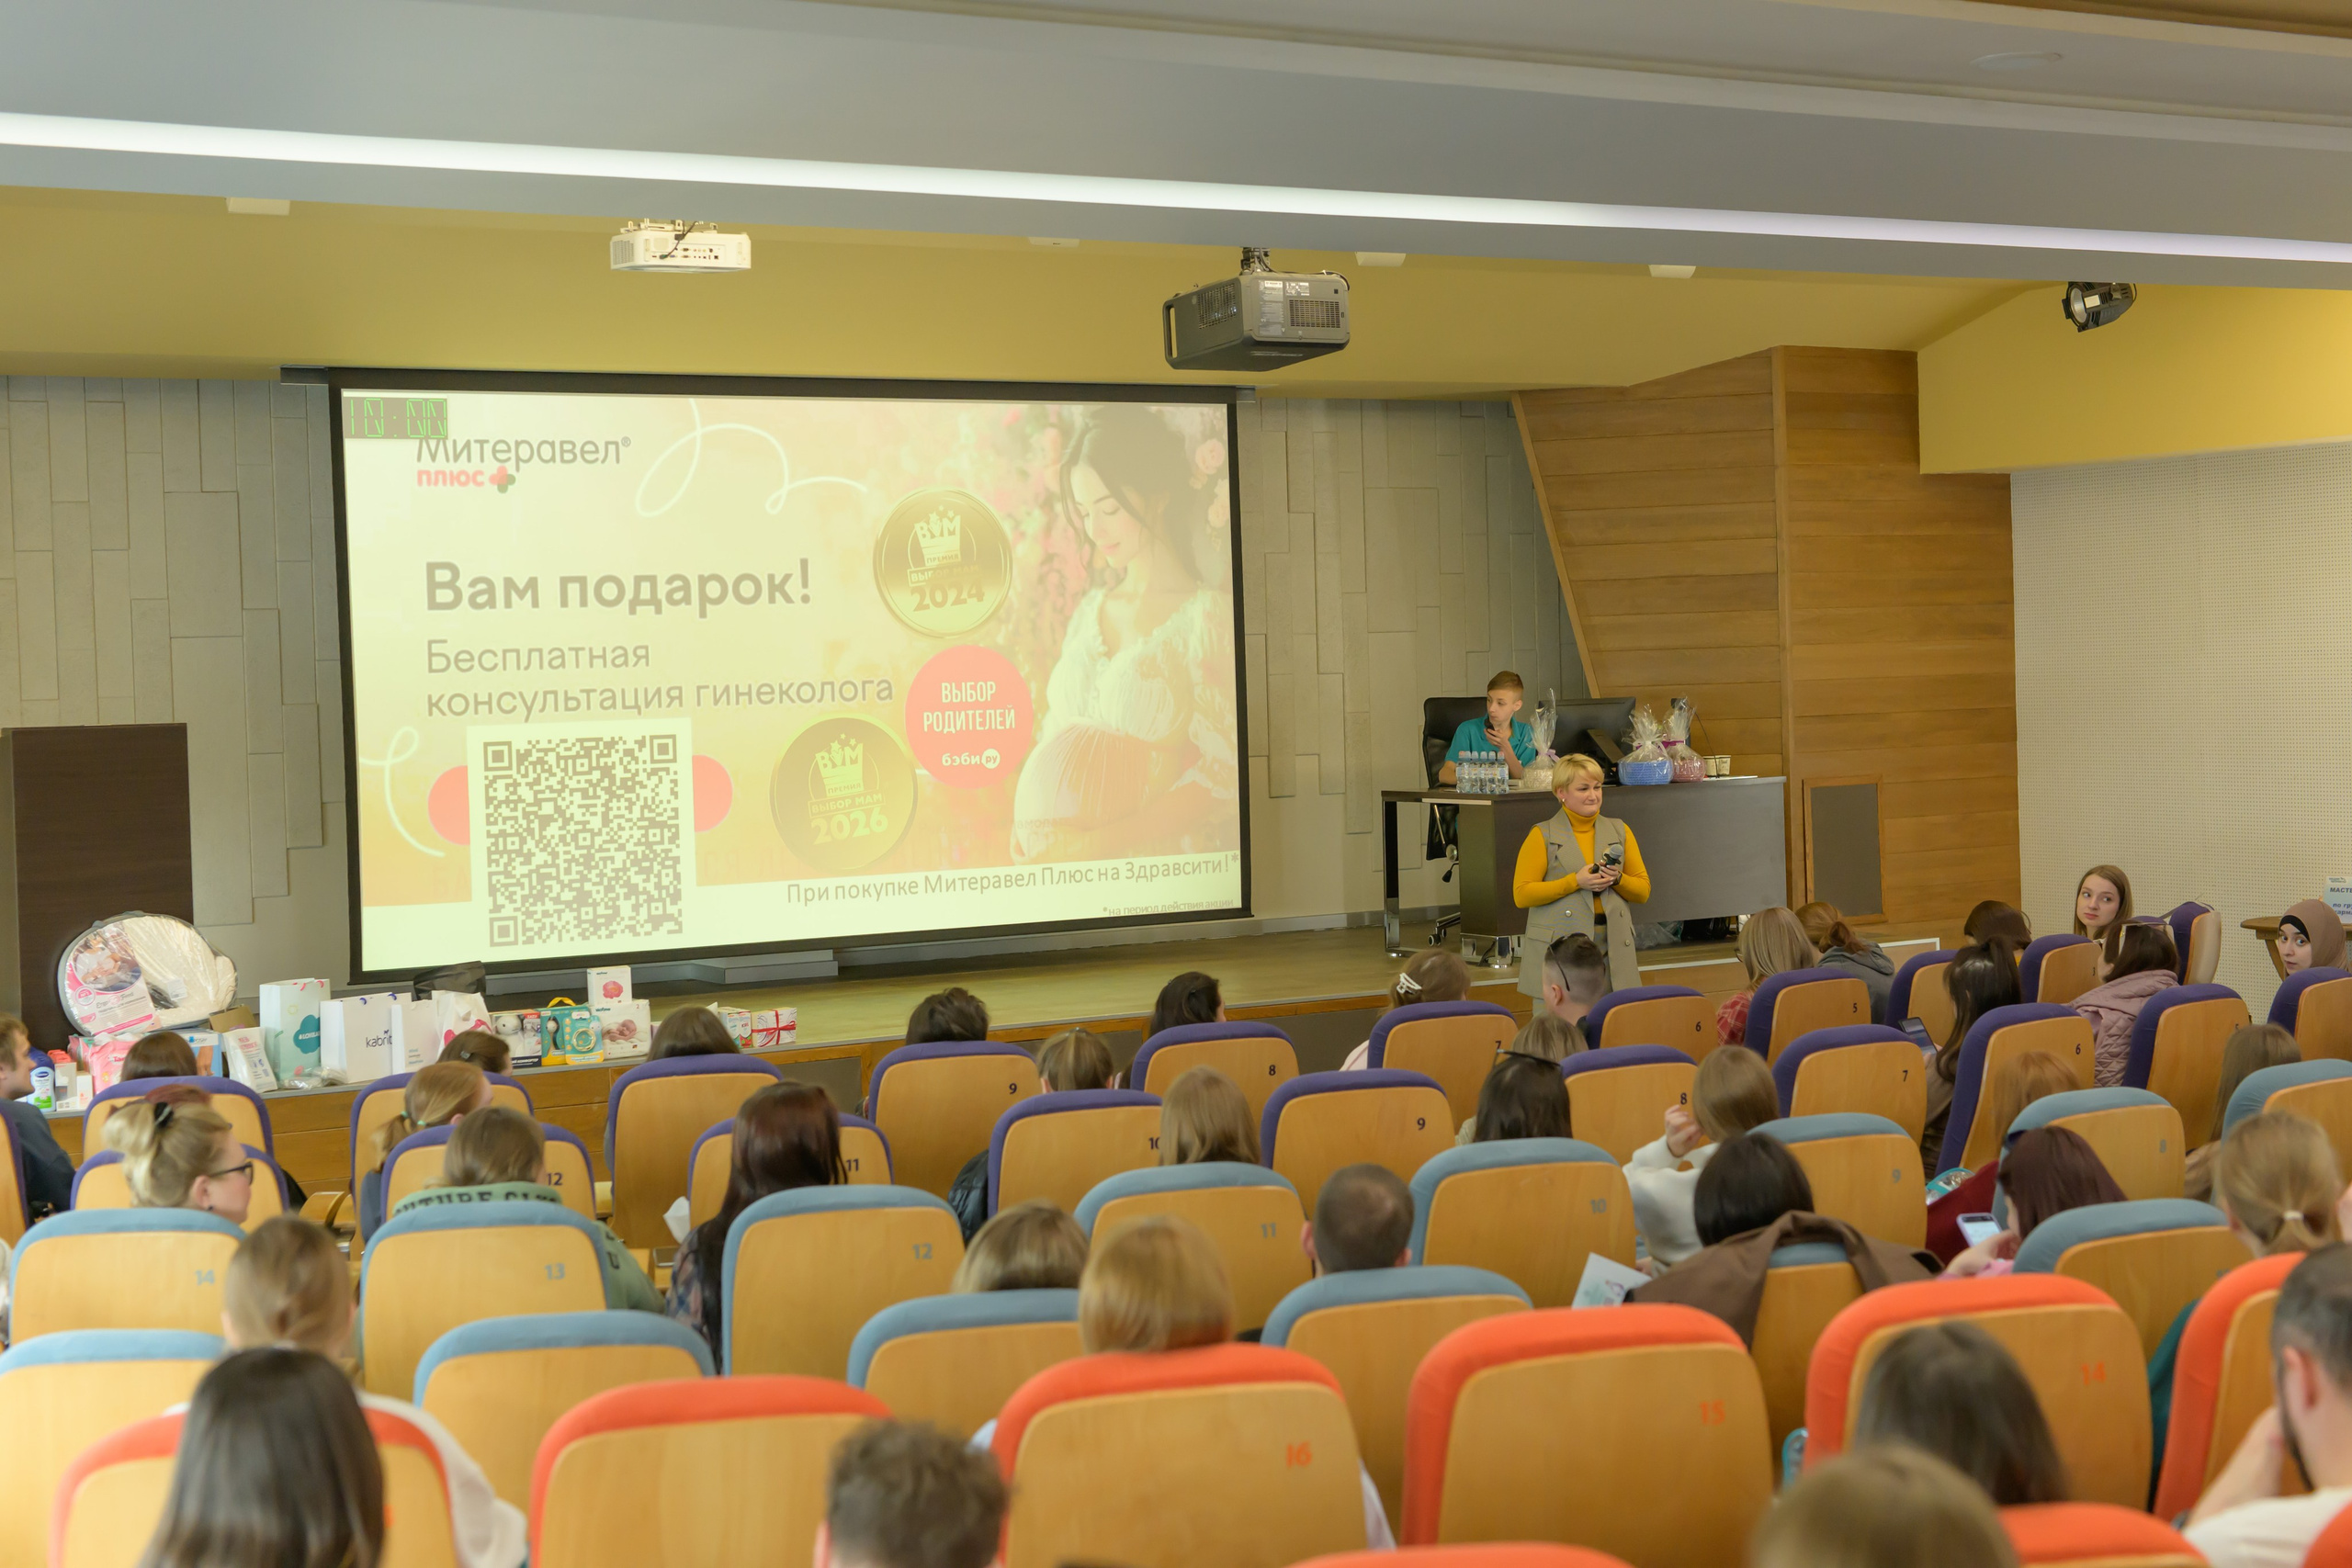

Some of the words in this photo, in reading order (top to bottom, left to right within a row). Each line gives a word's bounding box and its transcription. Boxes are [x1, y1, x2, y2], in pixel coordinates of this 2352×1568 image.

[926, 553, 959, 564] ПРЕМИЯ
[424, 561, 540, 612] Вам
[559, 558, 812, 619] подарок!
[910, 579, 986, 612] 2024
[426, 638, 651, 674] Бесплатная
[426, 683, 684, 724] консультация
[695, 675, 894, 708] гинеколога
[942, 681, 996, 703] ВЫБОР
[923, 704, 1015, 734] РОДИТЕЛЕЙ
[828, 783, 862, 794] ПРЕМИЯ
[811, 799, 853, 814] ВЫБОР
[854, 793, 883, 806] МАМ
[810, 807, 888, 845] 2026
[787, 884, 829, 907] При
[834, 880, 920, 902] покупке
[924, 872, 1036, 894] Митеравел
[1041, 866, 1094, 886] Плюс
[1098, 866, 1120, 882] на
[1123, 905, 1159, 915] период
[1160, 901, 1204, 912] действия
[1853, 1002, 1858, 1013] 5
[1695, 1021, 1702, 1032] 6
[366, 1030, 393, 1047] kabrit
[2075, 1043, 2081, 1055] 6
[1269, 1065, 1276, 1076] 8
[1902, 1069, 1908, 1082] 7
[1009, 1083, 1017, 1095] 9
[1680, 1092, 1687, 1105] 8
[1417, 1117, 1425, 1131] 9
[846, 1158, 859, 1171] 11
[548, 1172, 562, 1186] 12
[1892, 1168, 1901, 1183] 9
[1590, 1198, 1606, 1214] 10
[1261, 1223, 1276, 1239] 11
[912, 1242, 933, 1259] 12
[195, 1269, 215, 1286] 14
[545, 1262, 565, 1280] 13
[2080, 1362, 2106, 1388] 14
[1700, 1401, 1725, 1425] 15
[1285, 1441, 1312, 1470] 16
